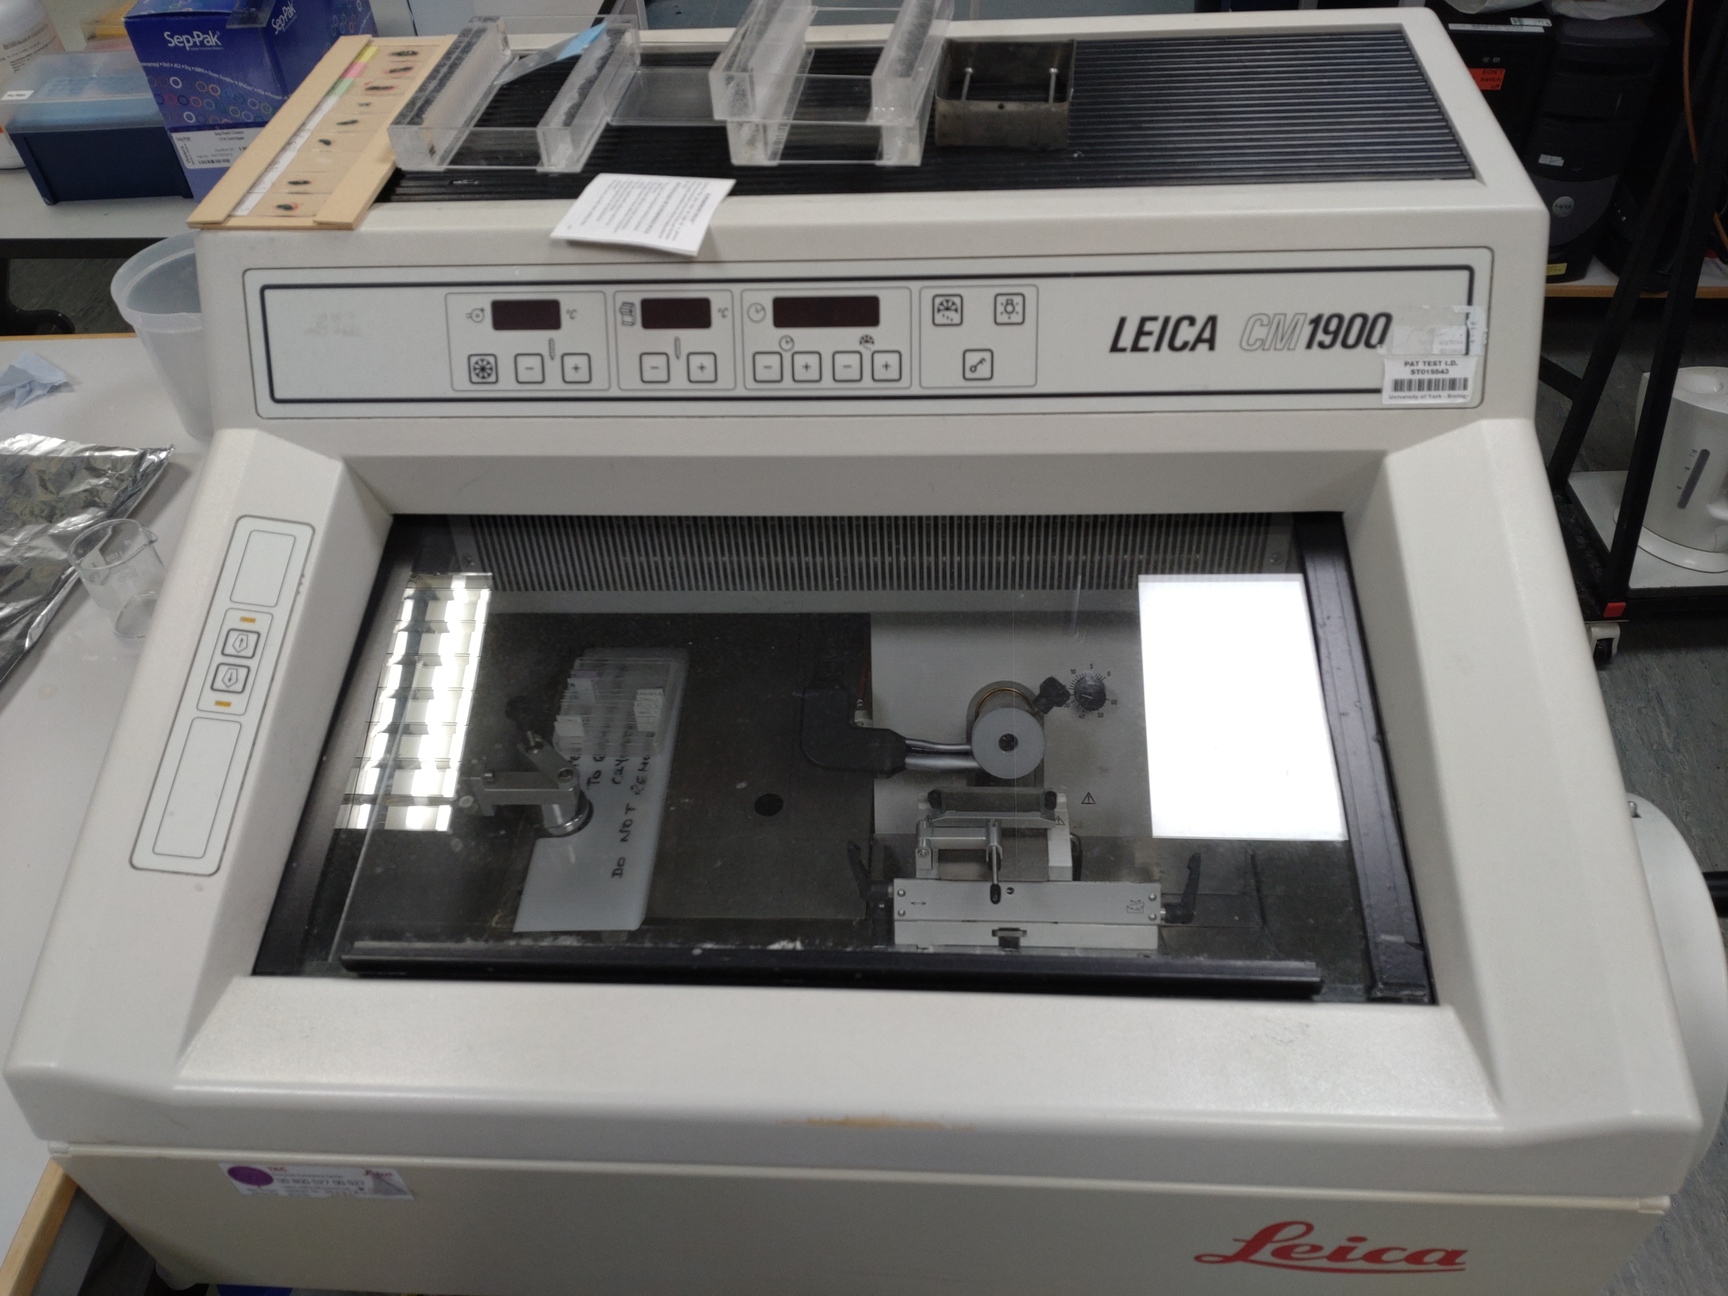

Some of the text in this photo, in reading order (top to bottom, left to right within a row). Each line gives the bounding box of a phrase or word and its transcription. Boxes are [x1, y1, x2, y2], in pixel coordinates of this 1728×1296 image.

[271, 1, 296, 34] Sep-Pak
[163, 30, 221, 50] Sep-Pak
[1109, 311, 1393, 353] LEICA CM1900
[620, 802, 636, 843] NOT
[1193, 1220, 1468, 1275] Leica
